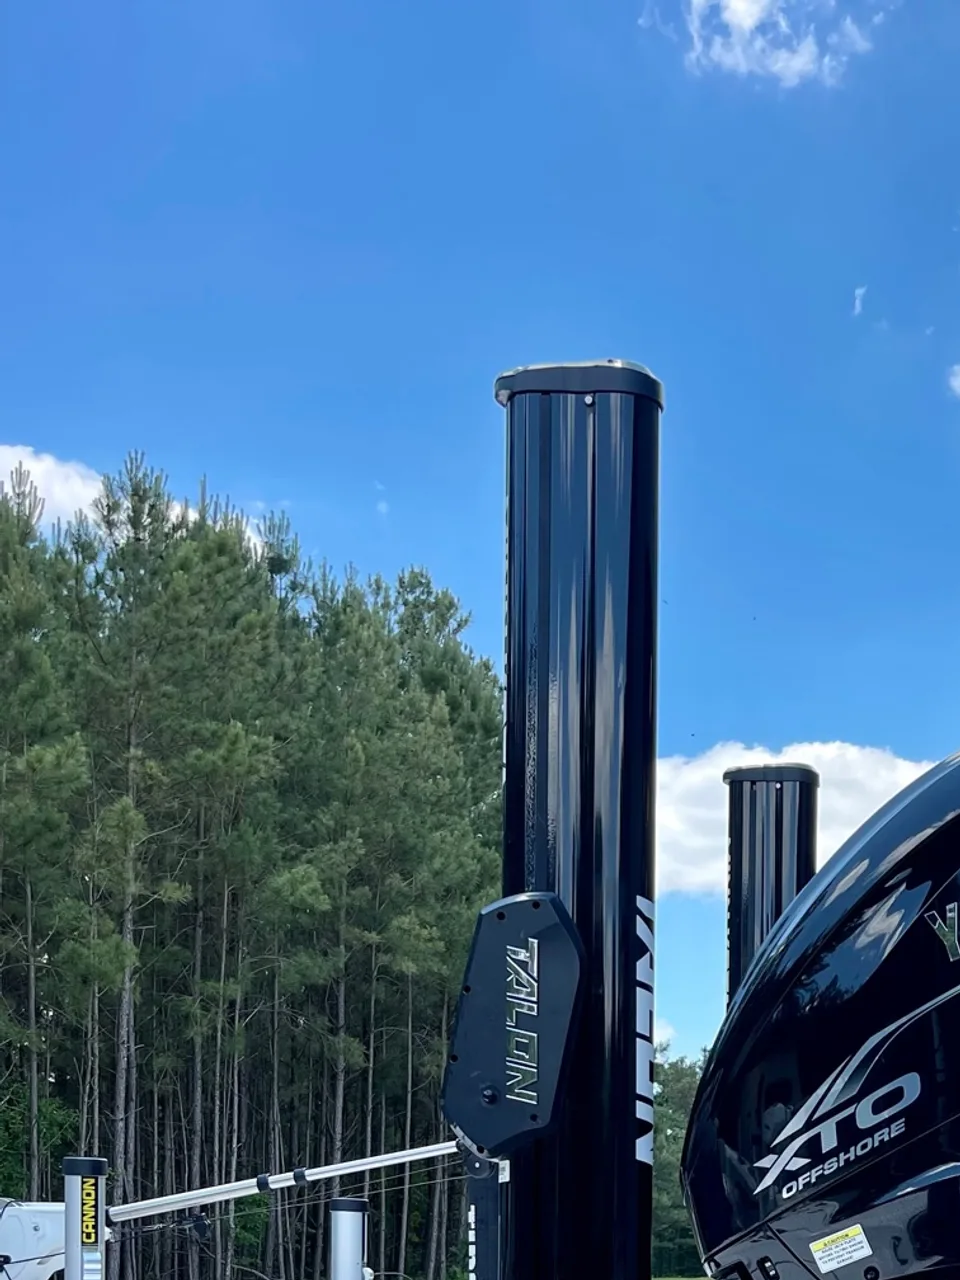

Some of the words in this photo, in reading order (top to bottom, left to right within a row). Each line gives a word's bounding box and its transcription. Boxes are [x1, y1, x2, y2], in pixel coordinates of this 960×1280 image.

[506, 937, 538, 1104] TALON
[753, 1055, 922, 1195] XTO
[782, 1118, 906, 1199] OFFSHORE
[82, 1177, 96, 1243] CANNON
